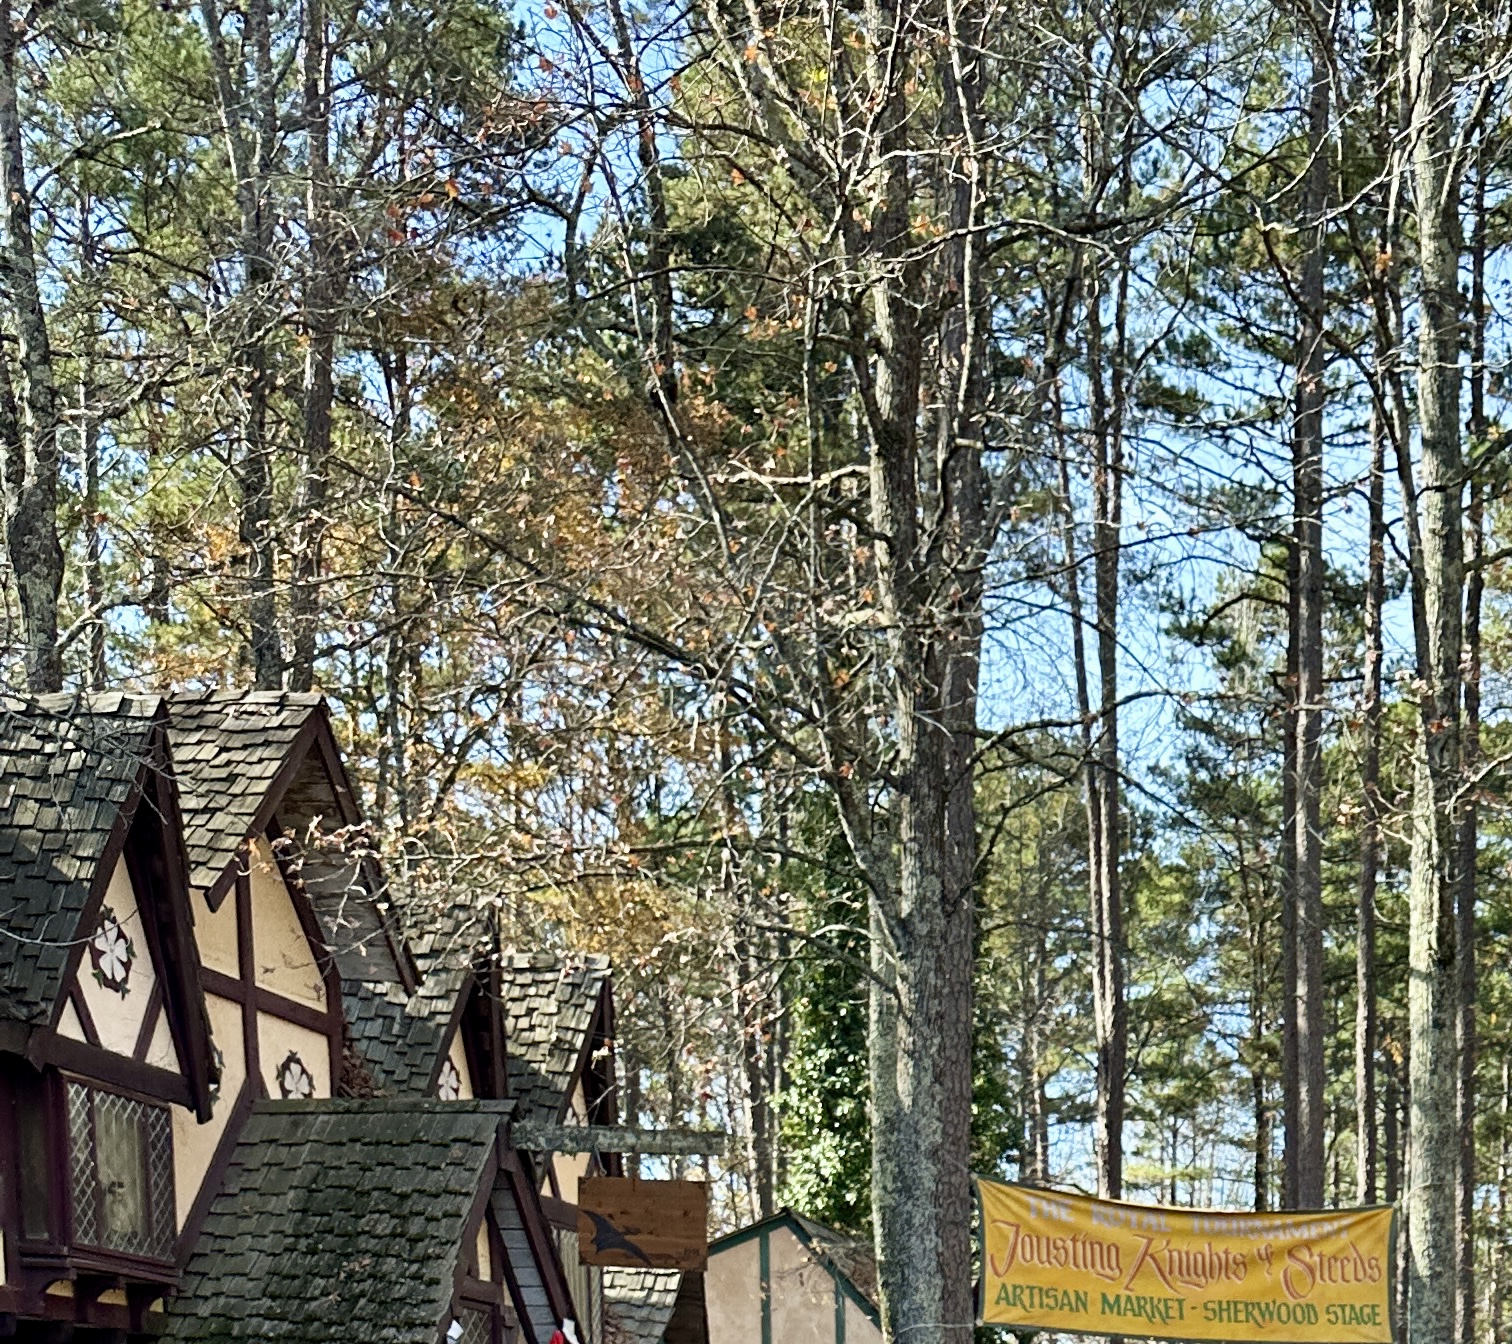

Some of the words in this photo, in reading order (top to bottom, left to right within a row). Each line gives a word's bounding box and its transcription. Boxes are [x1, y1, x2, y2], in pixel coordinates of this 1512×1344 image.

[1027, 1196, 1075, 1223] THE
[1092, 1202, 1172, 1233] ROYAL
[987, 1218, 1123, 1283] Jousting
[1123, 1233, 1248, 1295] Knights
[1281, 1241, 1382, 1300] Steeds
[994, 1282, 1089, 1313] ARTISAN
[1100, 1294, 1185, 1325] MARKET
[1204, 1299, 1318, 1329] SHERWOOD
[1325, 1303, 1382, 1326] STAGE
